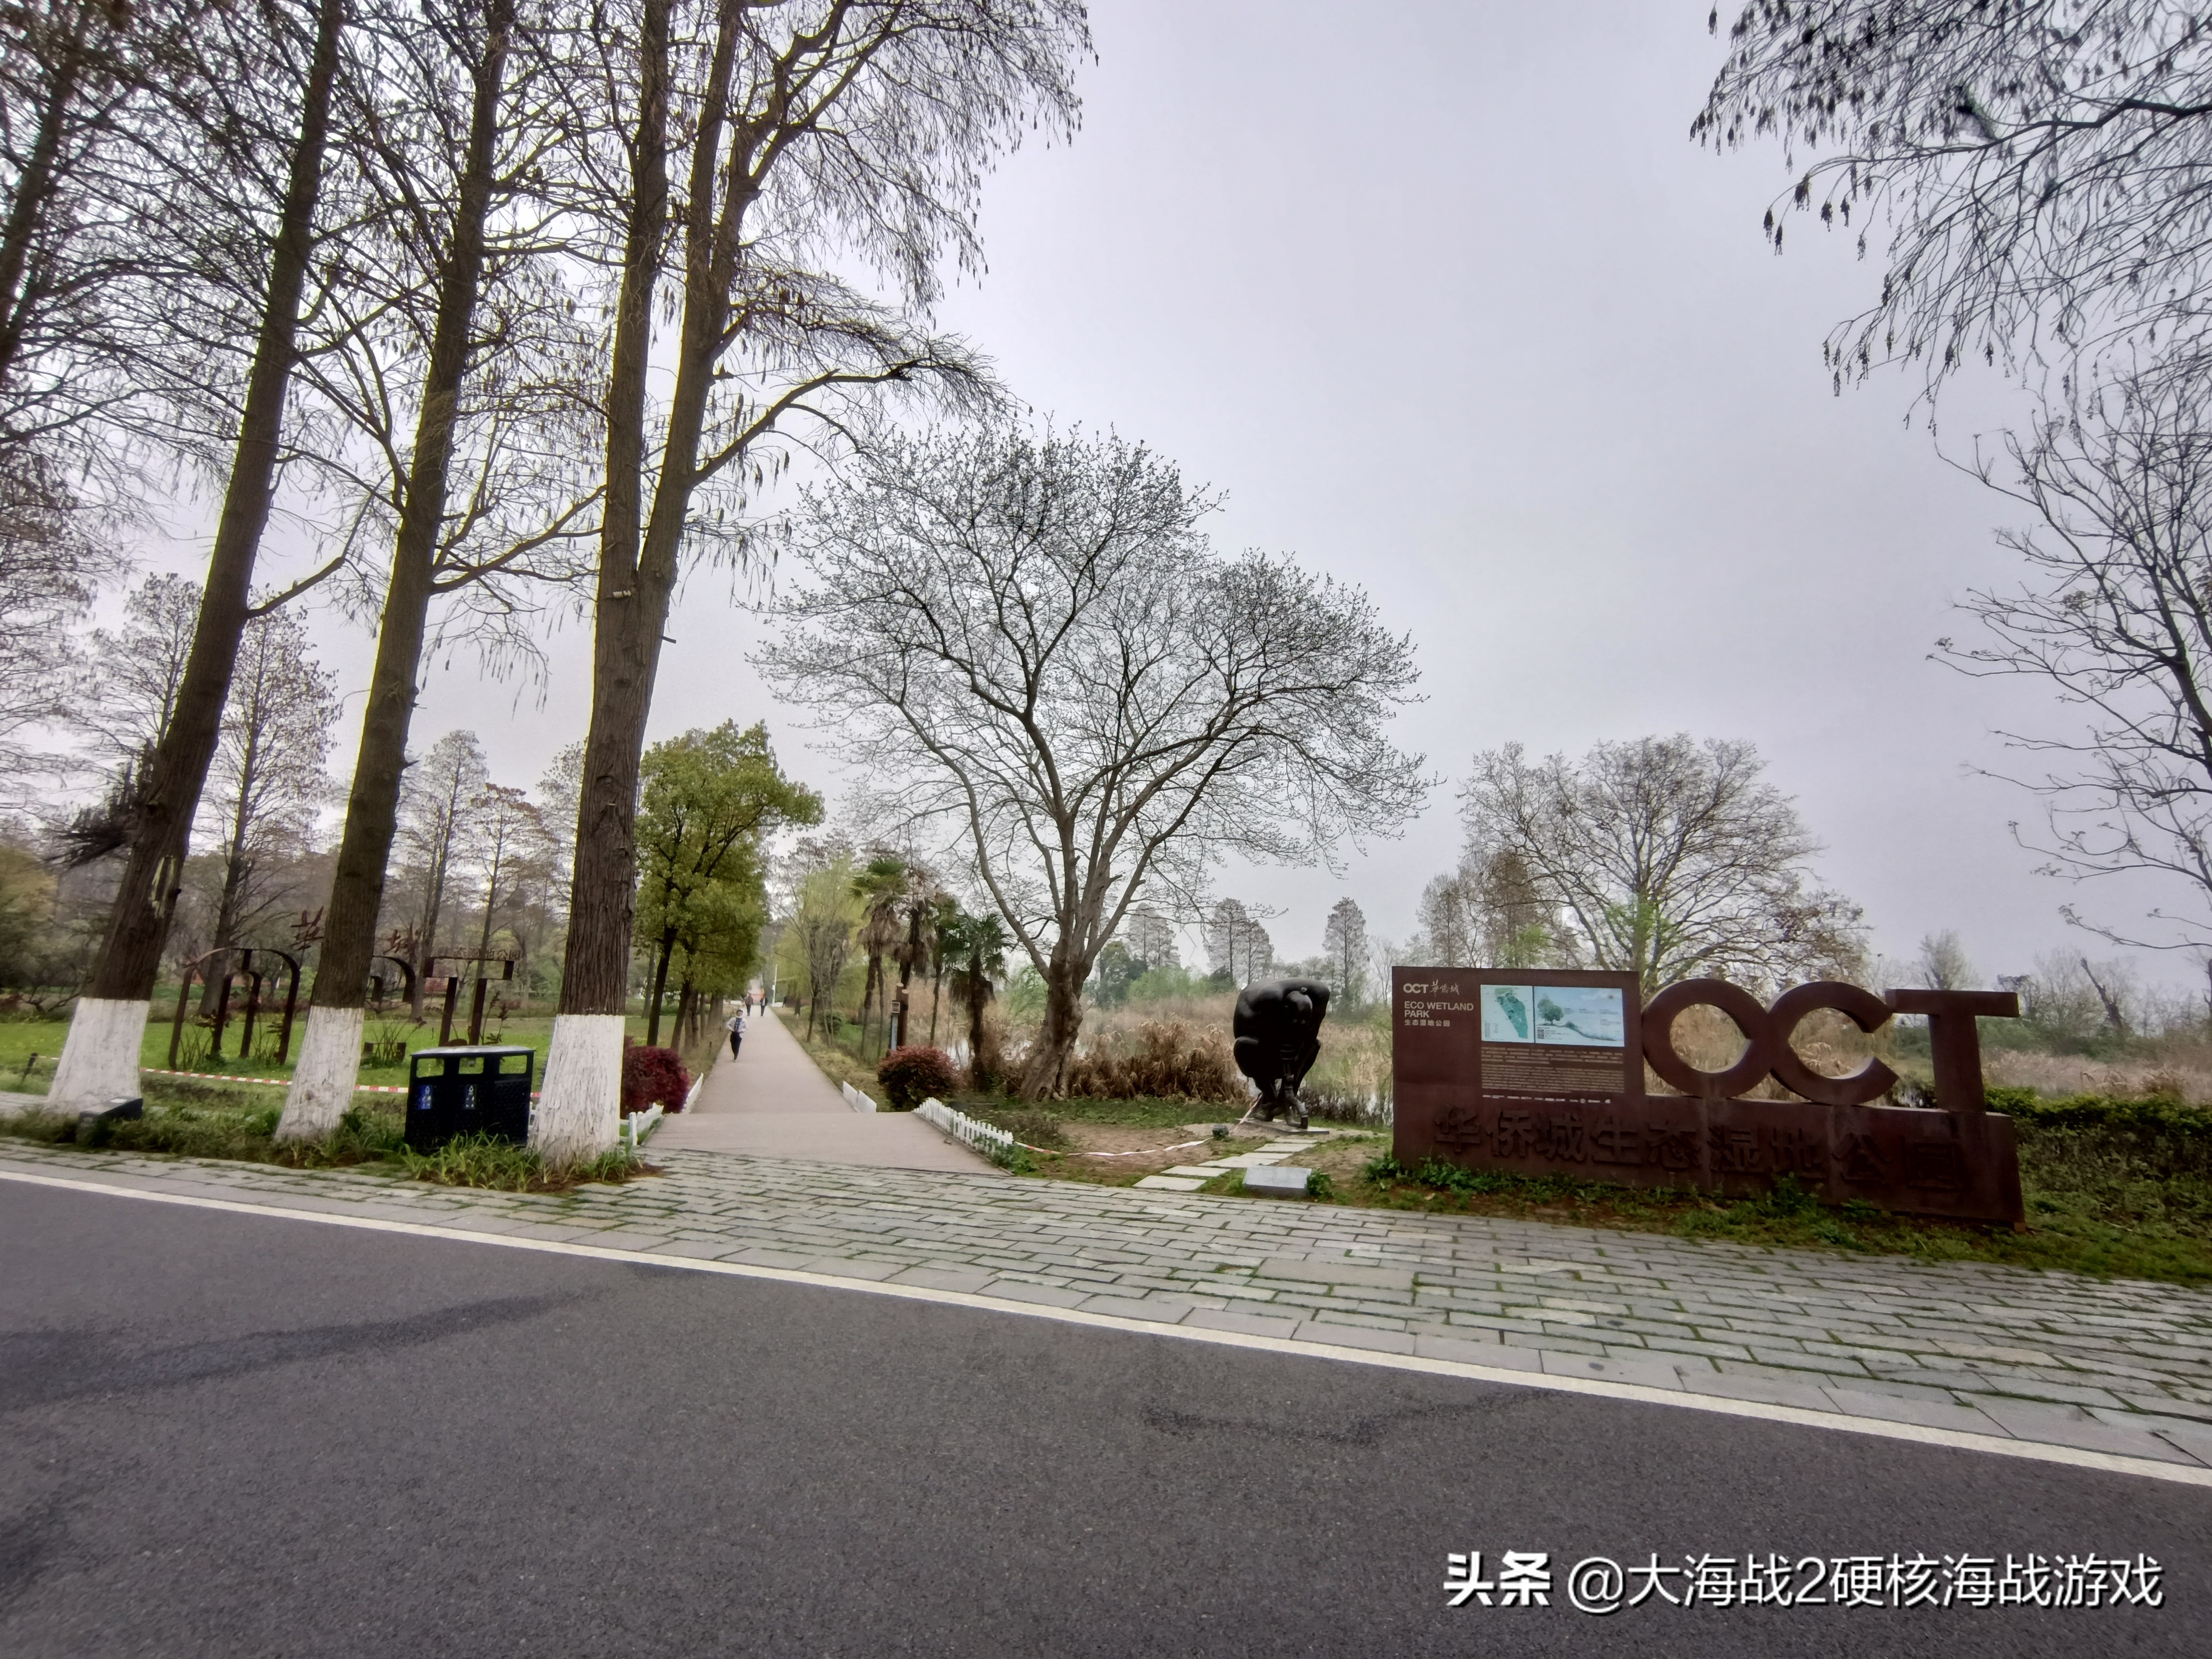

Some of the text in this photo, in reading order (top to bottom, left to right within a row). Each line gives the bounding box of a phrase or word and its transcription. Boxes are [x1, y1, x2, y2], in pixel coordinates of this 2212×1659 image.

[1403, 983, 1429, 994] OCT
[1404, 1001, 1474, 1011] ECO WETLAND
[1642, 978, 2019, 1113] OCT
[1433, 1105, 1963, 1192] 华侨城生态湿地公园
